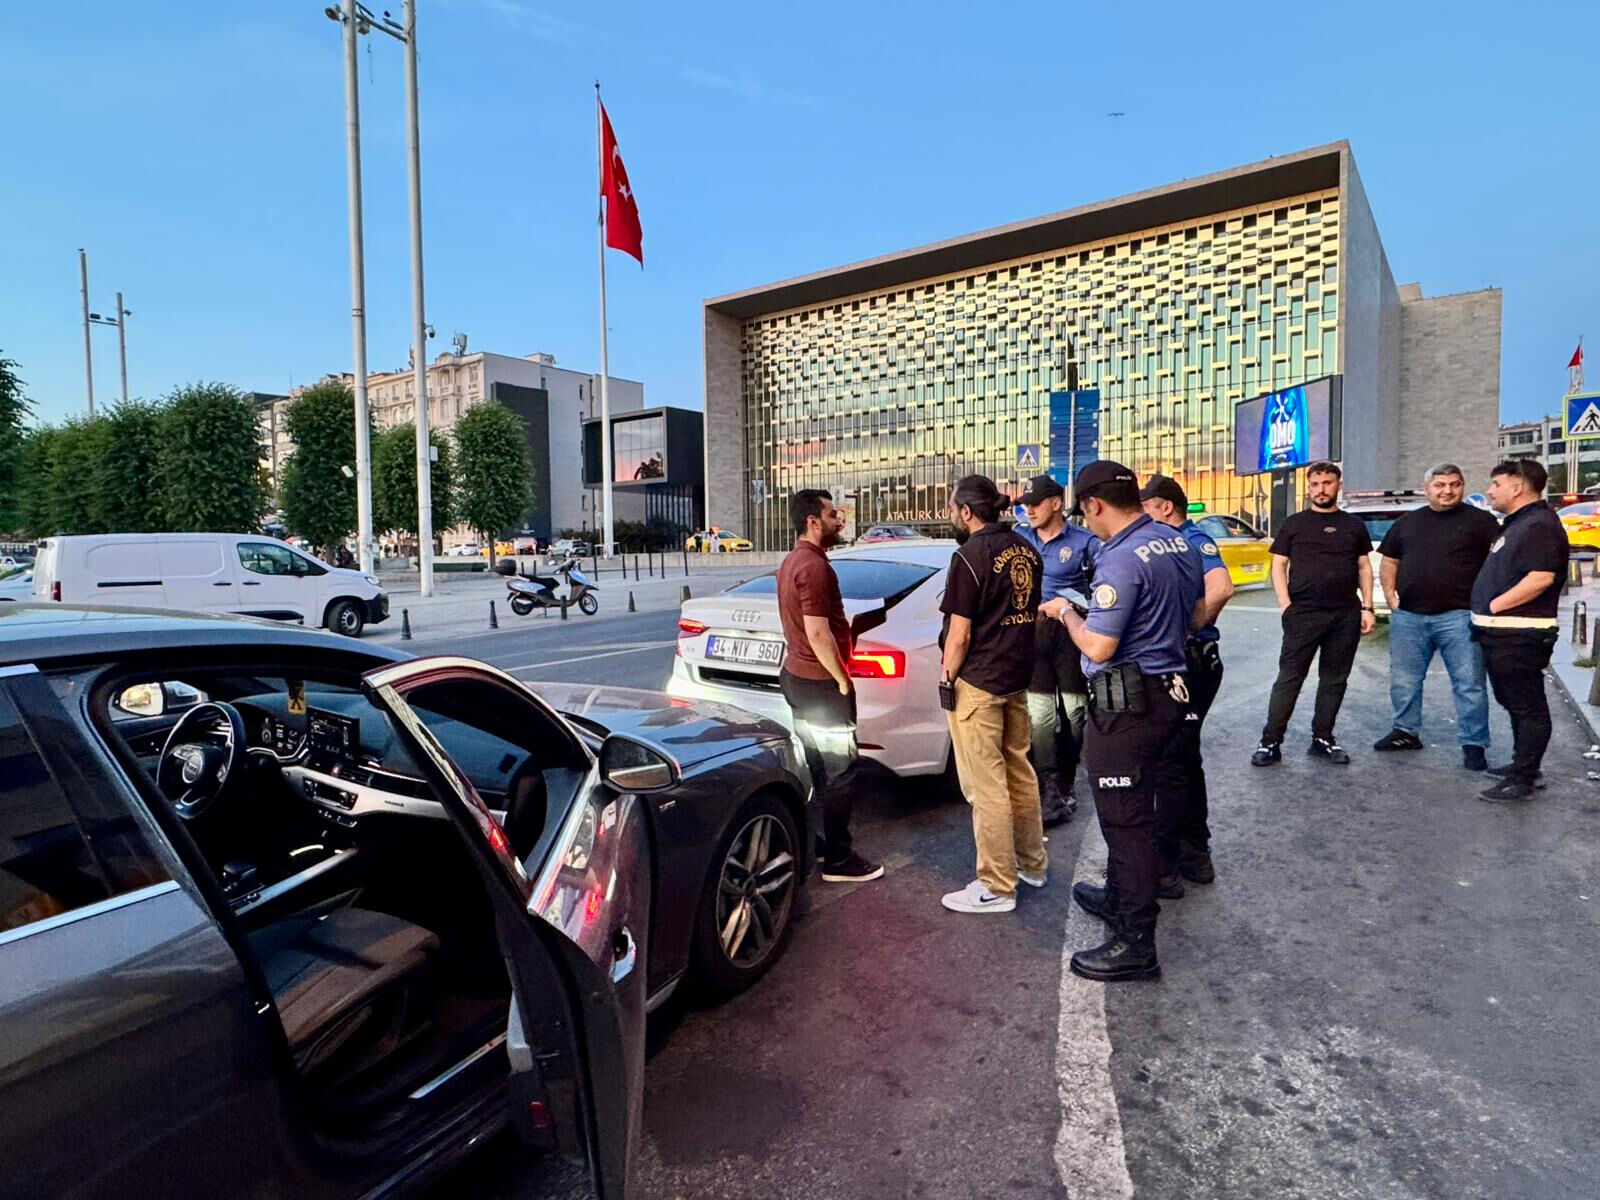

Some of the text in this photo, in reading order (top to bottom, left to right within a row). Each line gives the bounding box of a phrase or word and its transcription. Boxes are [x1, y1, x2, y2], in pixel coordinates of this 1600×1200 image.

[1269, 419, 1296, 448] OMO
[714, 639, 726, 655] 34
[758, 643, 779, 660] 960
